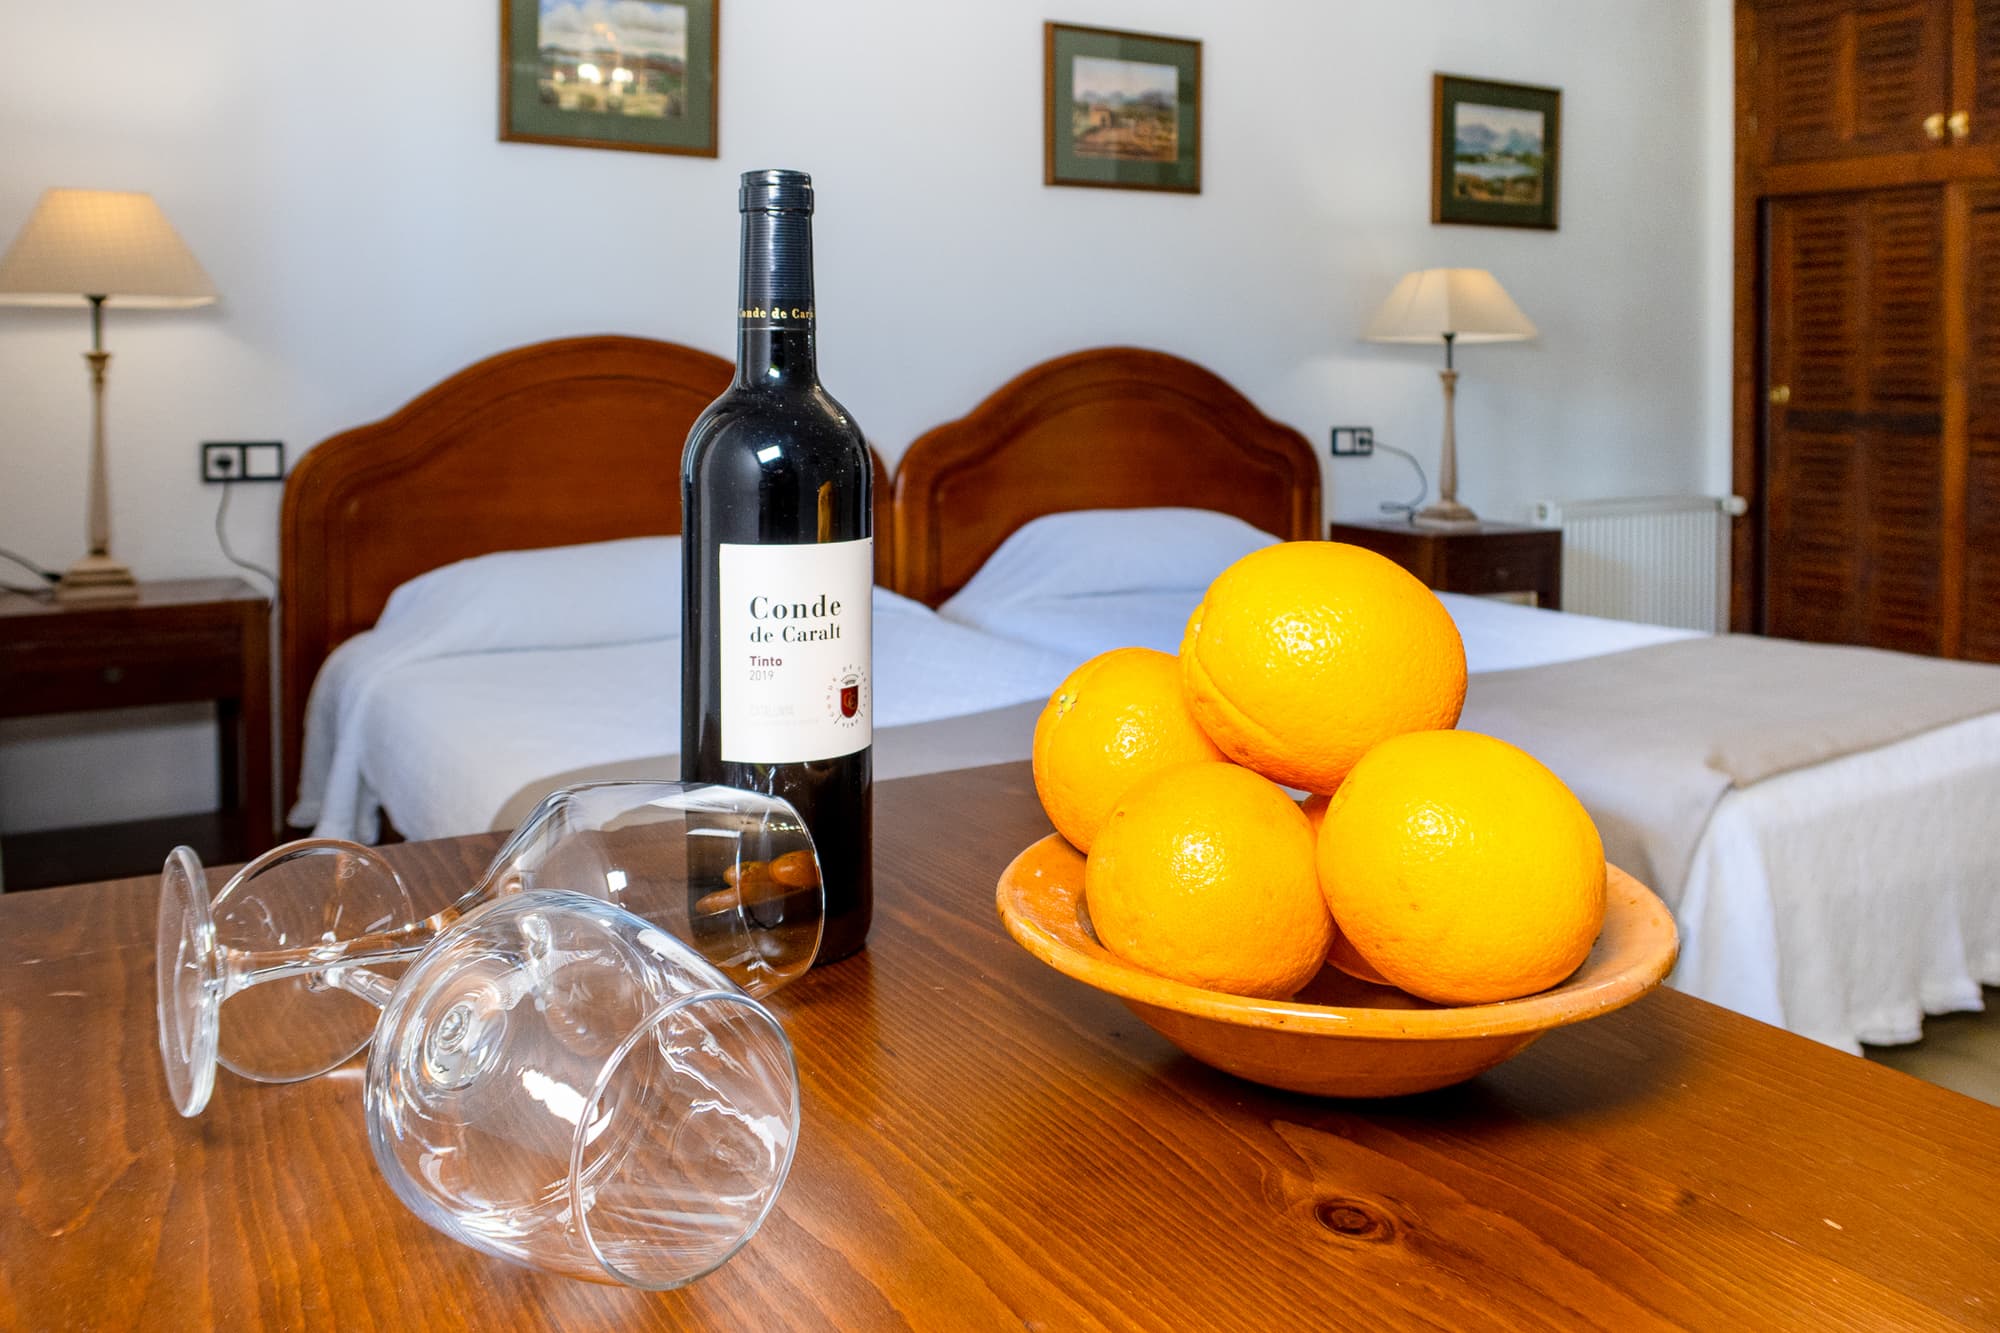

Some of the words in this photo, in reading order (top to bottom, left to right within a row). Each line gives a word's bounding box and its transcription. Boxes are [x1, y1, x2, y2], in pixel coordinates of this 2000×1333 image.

[771, 307, 787, 319] de
[750, 594, 841, 620] Conde
[750, 626, 774, 643] de
[782, 623, 841, 643] Caralt
[749, 656, 783, 667] Tinto
[749, 670, 774, 681] 2019
